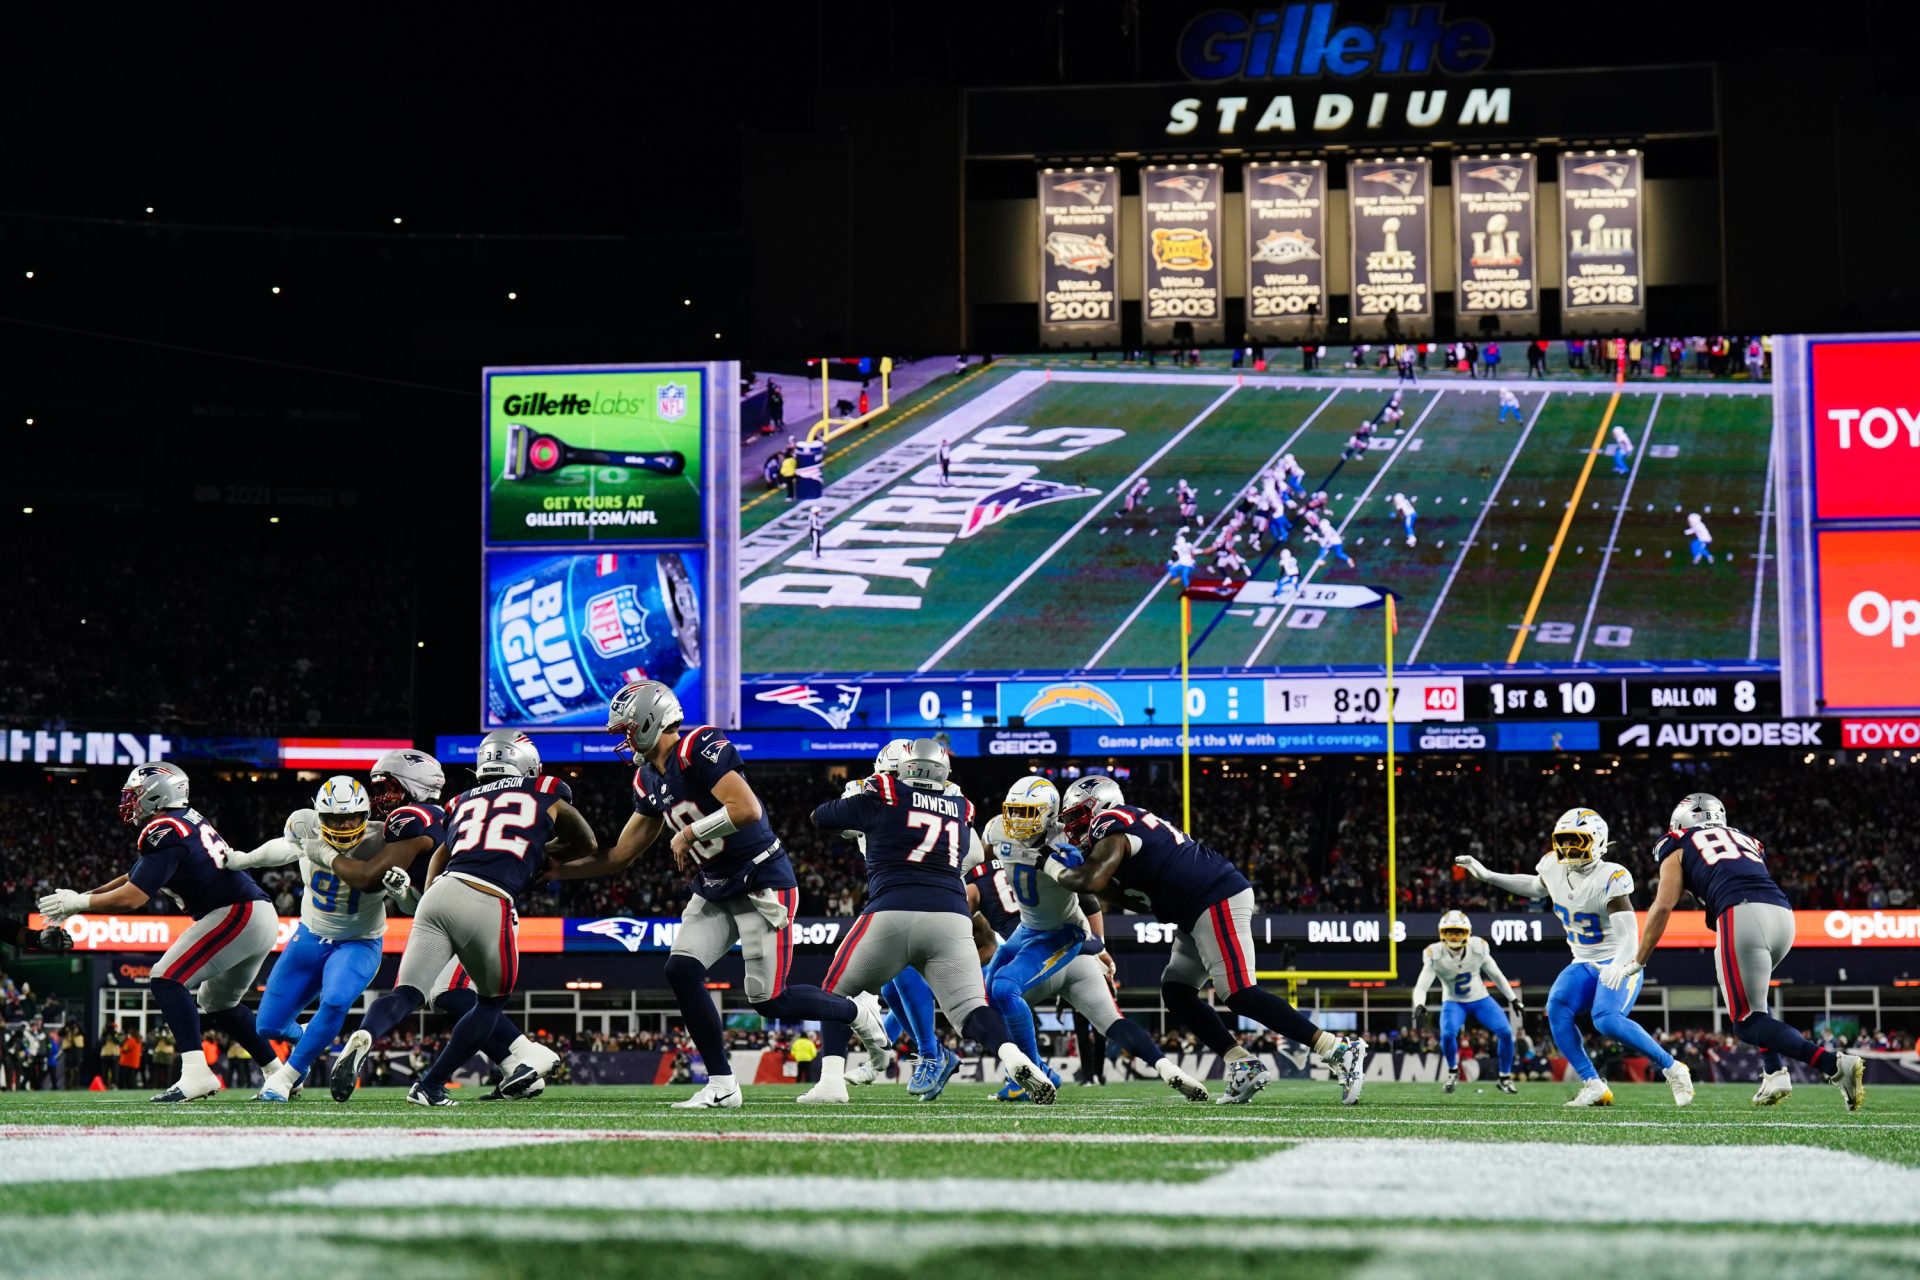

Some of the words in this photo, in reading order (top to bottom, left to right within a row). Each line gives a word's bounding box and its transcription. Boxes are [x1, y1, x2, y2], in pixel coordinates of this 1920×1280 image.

[1178, 2, 1494, 81] Gillette
[1165, 88, 1511, 135] STADIUM
[1264, 274, 1308, 285] WORLD
[1368, 272, 1413, 284] WORLD
[1473, 269, 1519, 280] WORLD
[1579, 264, 1625, 275] WORLD
[1058, 280, 1101, 291] WORLD
[1160, 277, 1204, 288] WORLD
[1252, 285, 1320, 297] CHAMPIONS
[1357, 284, 1426, 295] CHAMPIONS
[1462, 280, 1531, 291] CHAMPIONS
[1567, 276, 1638, 287] CHAMPIONS
[1046, 291, 1113, 302] CHAMPIONS
[1149, 288, 1217, 299] CHAMPIONS
[1467, 291, 1528, 309] 2016
[1572, 286, 1634, 304] 2018
[1050, 302, 1110, 320] 2001
[1150, 299, 1216, 317] 2003
[1361, 295, 1423, 313] 2014
[503, 392, 591, 416] Gillette
[592, 390, 640, 415] Labs
[660, 399, 683, 413] NFL
[543, 496, 572, 510] GET
[573, 495, 623, 509] YOURS
[626, 495, 645, 508] AT
[526, 511, 658, 527] GILLETTE.COM/NFL
[740, 425, 1126, 609] PATRIOTS
[592, 599, 623, 651] NFL
[1536, 622, 1634, 648] 20
[501, 578, 567, 716] LIGHT
[530, 581, 586, 698] BUD
[919, 691, 940, 721] 0
[1184, 687, 1206, 717] 0
[1334, 688, 1400, 712] 8:07
[1427, 689, 1456, 709] 40
[1534, 690, 1547, 708] &
[1559, 682, 1595, 714] 10
[1651, 688, 1690, 706] BALL
[1693, 688, 1717, 706] ON
[1734, 680, 1756, 712] 8
[1098, 736, 1138, 748] Game
[1140, 735, 1174, 750] plan:
[1203, 734, 1227, 747] the
[1228, 734, 1246, 747] W
[1246, 733, 1276, 747] with
[1277, 734, 1316, 750] great
[1318, 733, 1384, 749] coverage.
[1419, 735, 1486, 749] GEICO
[1656, 722, 1822, 747] AUTODESK
[1844, 721, 1920, 745] TOYO
[487, 751, 502, 761] 32
[989, 740, 1057, 754] GEICO
[917, 768, 930, 777] 71
[470, 776, 525, 797] HENDERSON
[912, 791, 959, 818] ONWENU
[451, 791, 538, 860] 32
[907, 810, 960, 869] 71
[310, 869, 362, 915] 91
[1013, 863, 1039, 908] 0
[63, 915, 169, 948] Optum
[1134, 921, 1178, 944] 1ST
[1307, 920, 1351, 943] BALL
[1353, 920, 1380, 943] ON
[1390, 921, 1406, 943] 8
[1491, 920, 1528, 945] QTR
[1530, 920, 1542, 942] 1
[1454, 972, 1473, 996] 2
